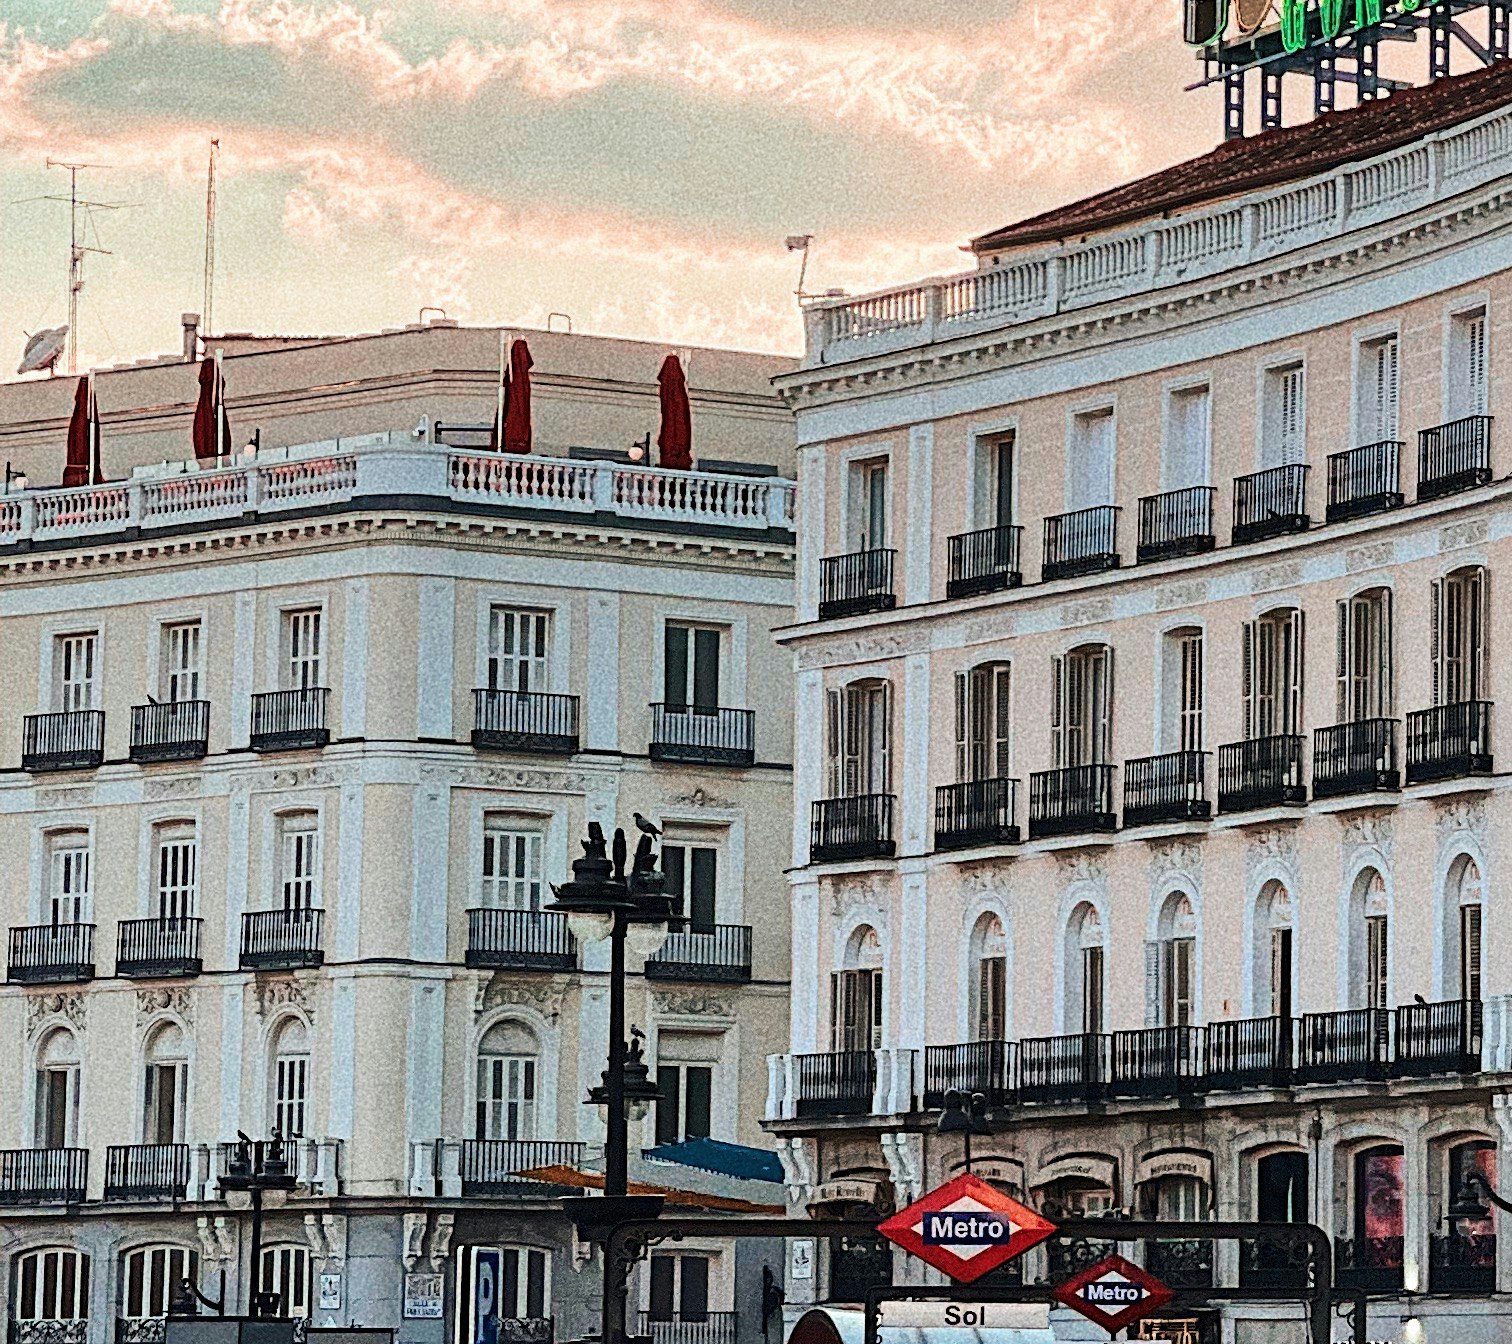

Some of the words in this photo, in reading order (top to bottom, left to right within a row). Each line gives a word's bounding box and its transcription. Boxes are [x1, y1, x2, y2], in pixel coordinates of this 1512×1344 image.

[931, 1218, 1004, 1239] Metro
[1087, 1284, 1139, 1301] Metro
[944, 1305, 985, 1325] Sol
